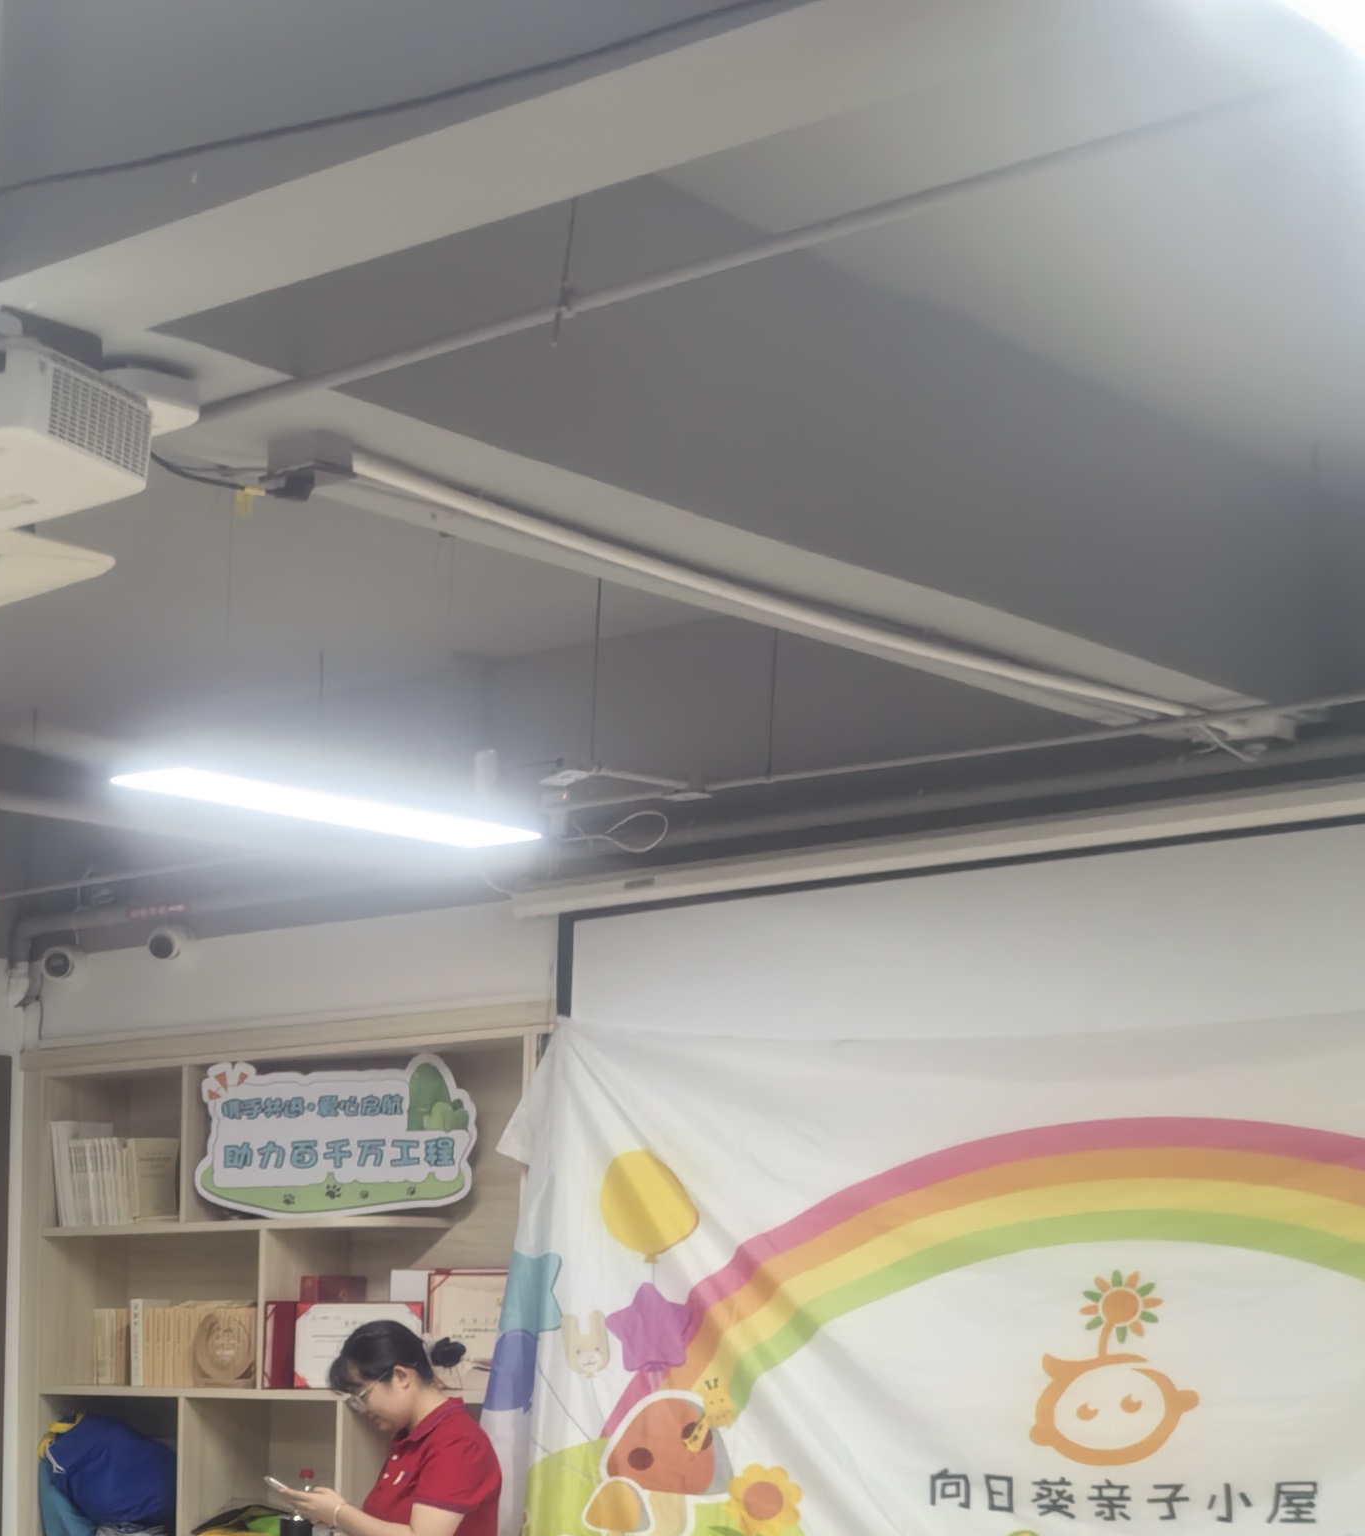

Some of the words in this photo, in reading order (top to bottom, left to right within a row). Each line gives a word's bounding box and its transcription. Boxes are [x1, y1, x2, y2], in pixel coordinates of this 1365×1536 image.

[222, 1135, 457, 1170] 助力百千万工程
[928, 1468, 1320, 1525] 向日葵亲子小屋
